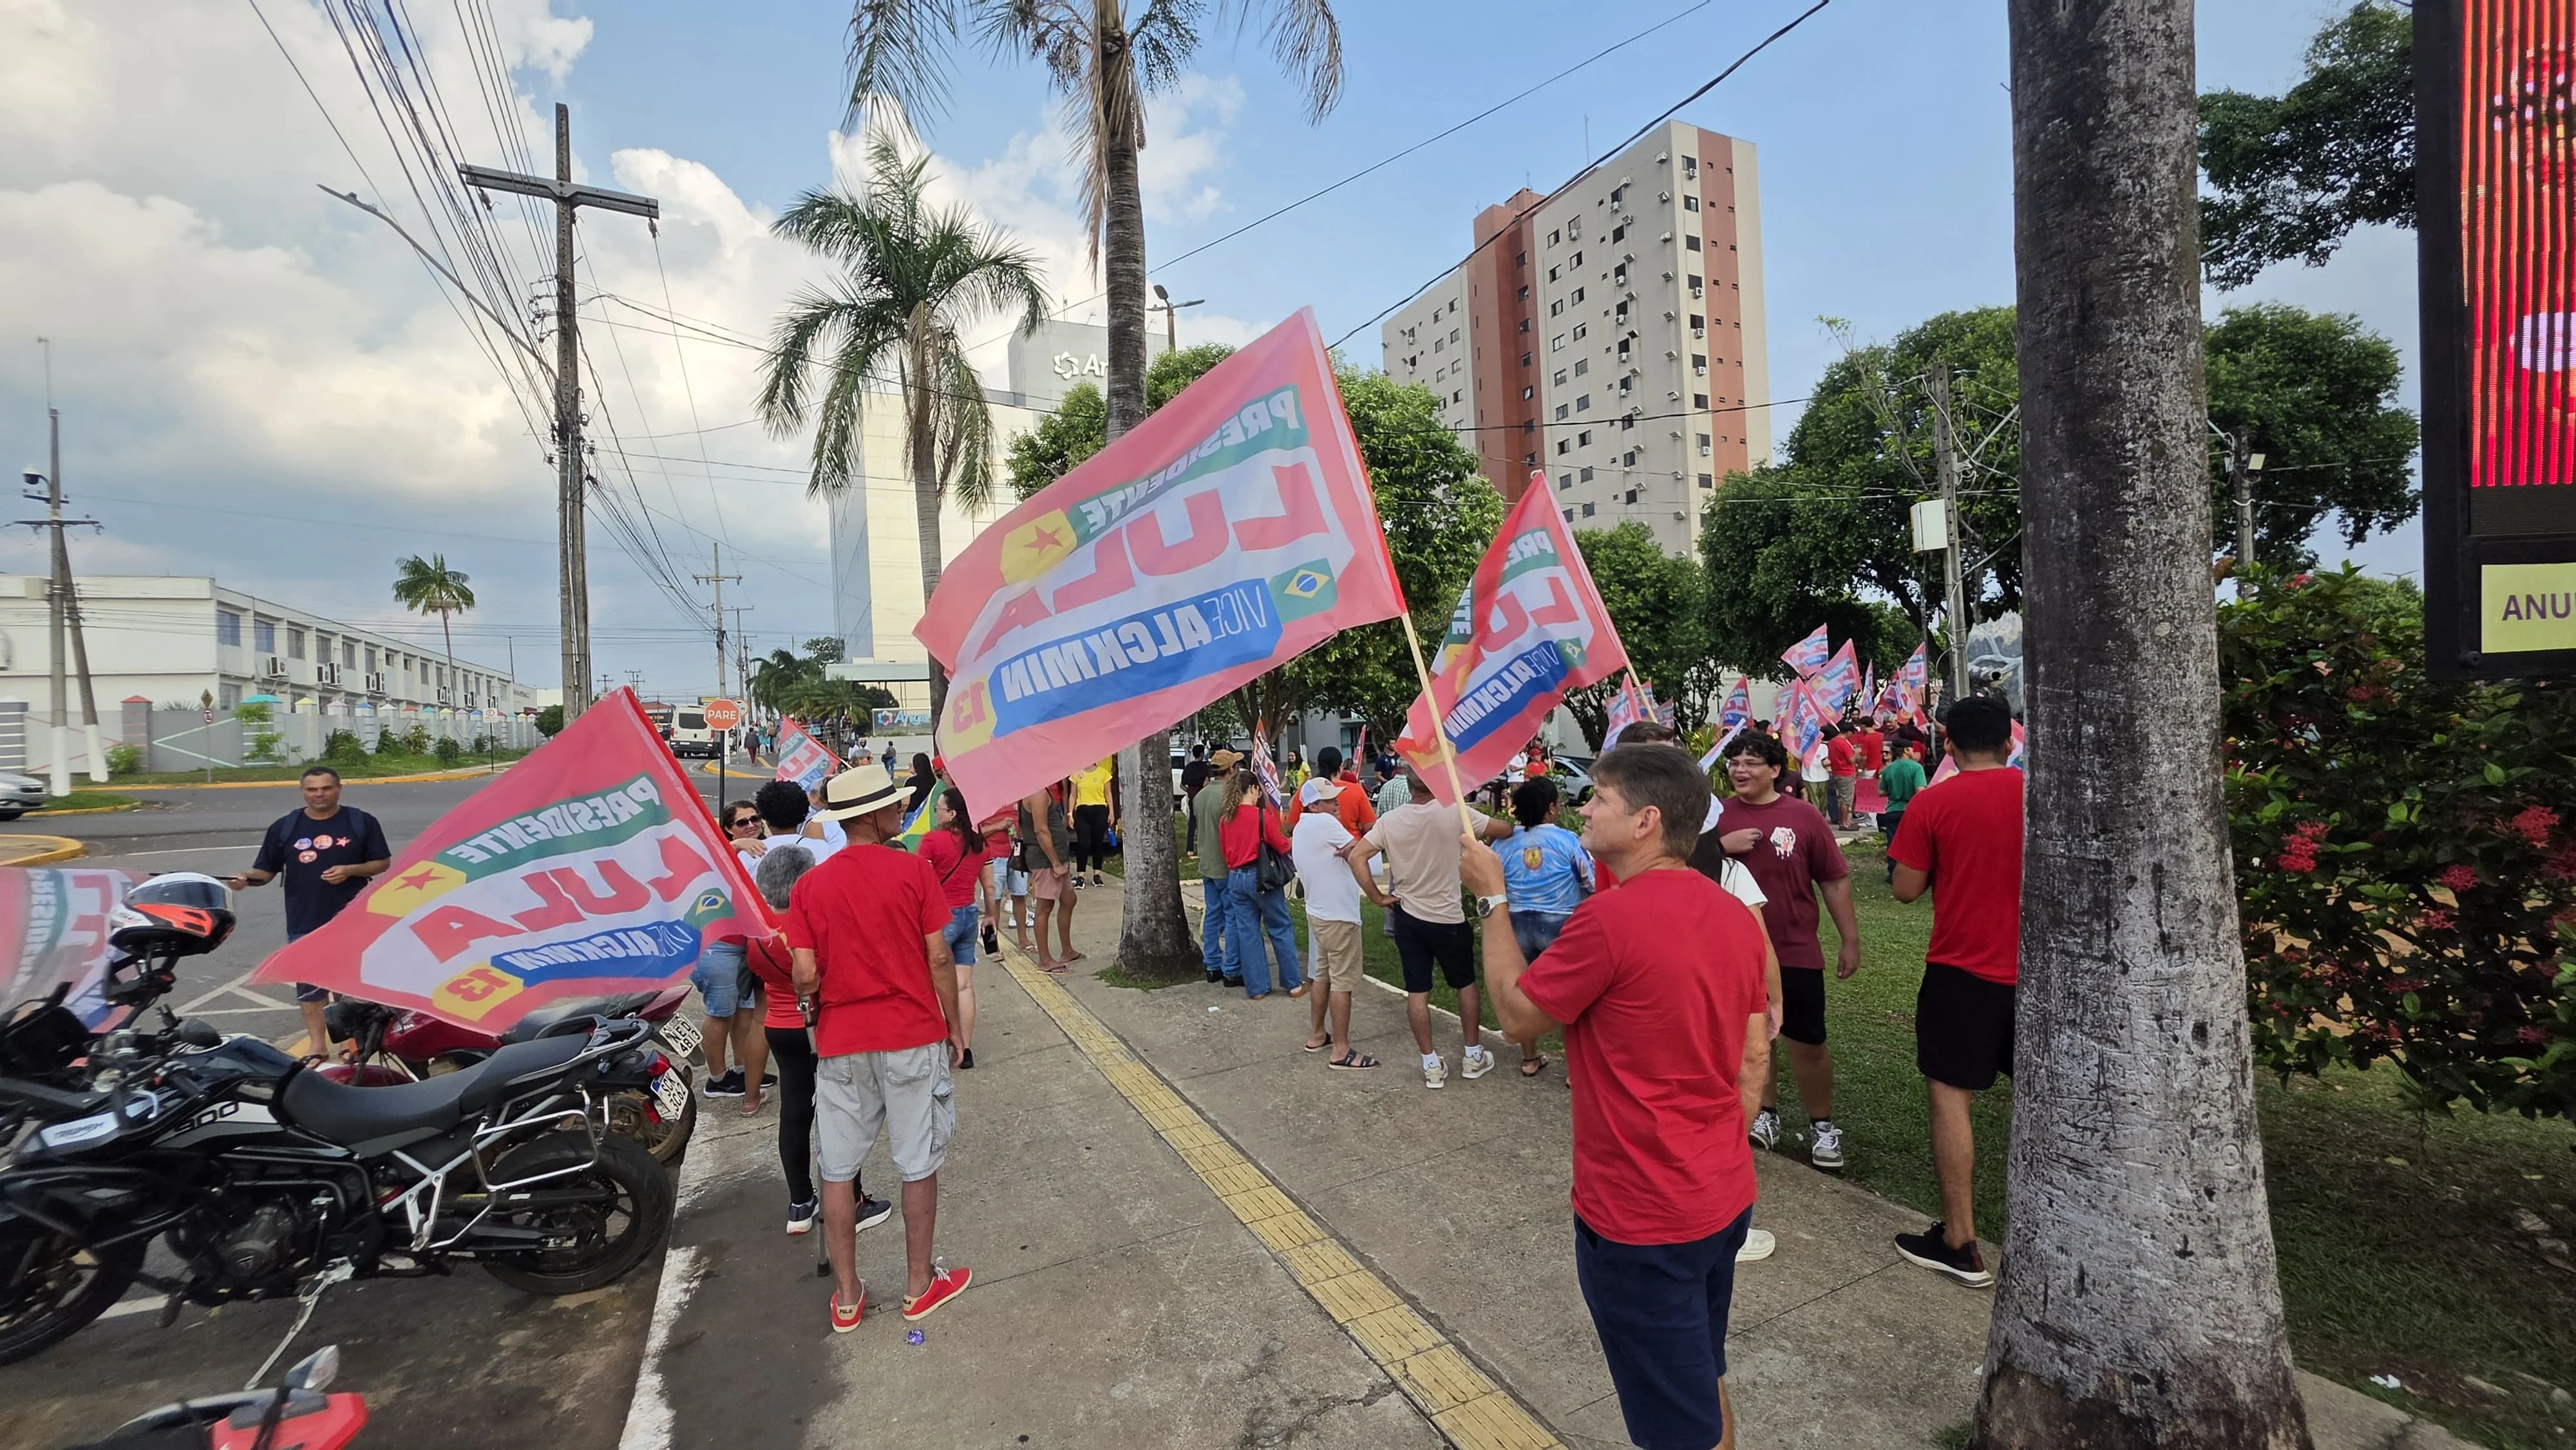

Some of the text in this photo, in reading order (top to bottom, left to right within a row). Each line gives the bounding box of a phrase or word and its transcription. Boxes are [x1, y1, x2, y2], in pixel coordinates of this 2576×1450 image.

[2501, 592, 2576, 621] ANU
[708, 710, 737, 720] PARE
[670, 1021, 691, 1044] NED
[680, 1030, 700, 1053] 4813
[661, 1072, 676, 1097] SCK
